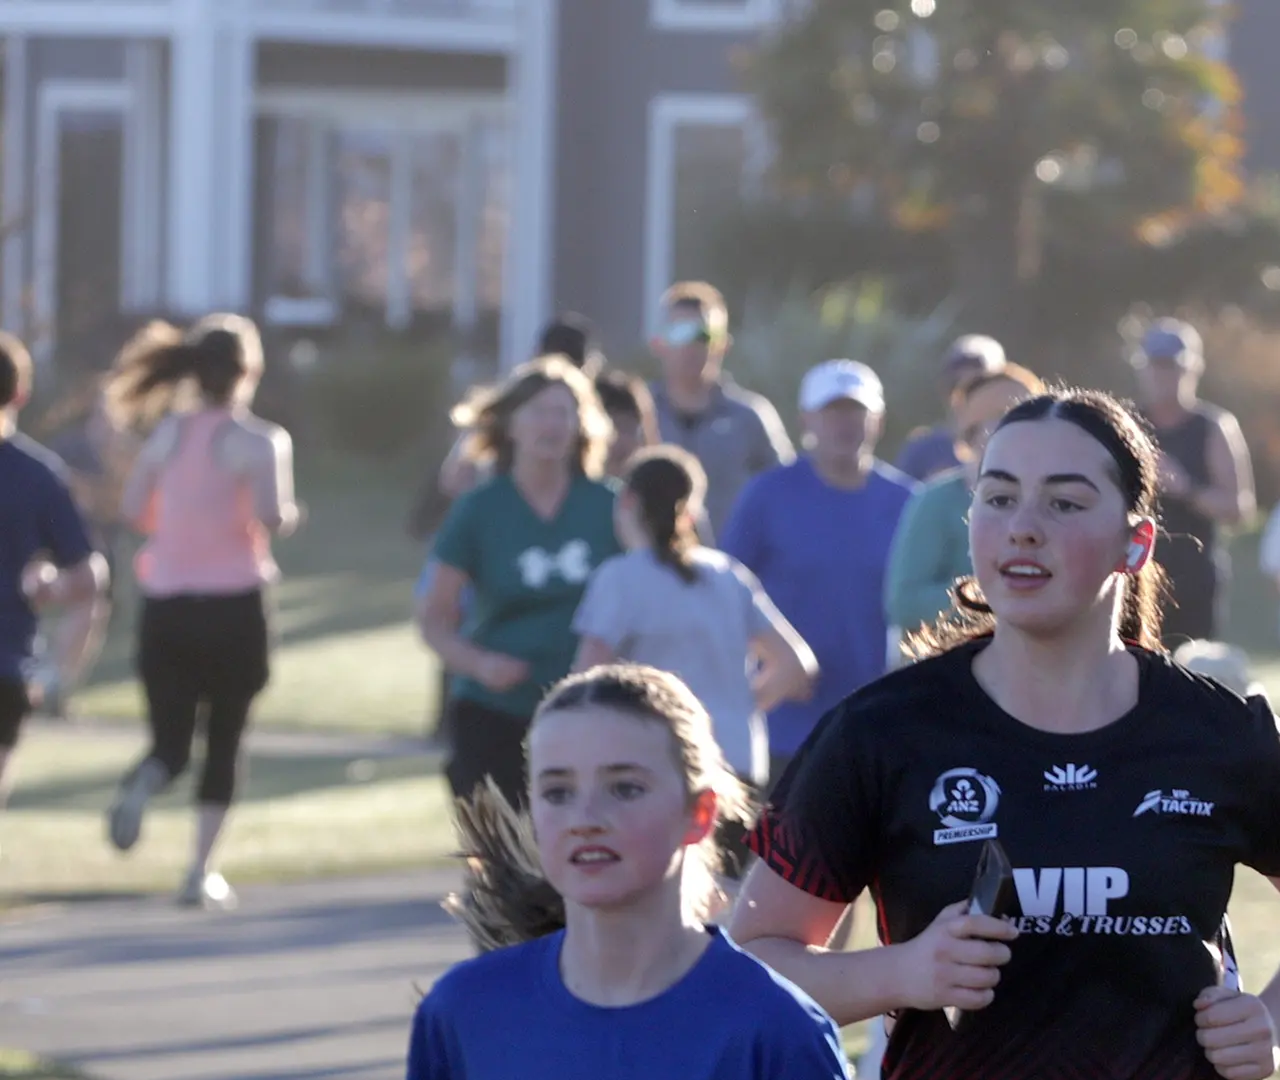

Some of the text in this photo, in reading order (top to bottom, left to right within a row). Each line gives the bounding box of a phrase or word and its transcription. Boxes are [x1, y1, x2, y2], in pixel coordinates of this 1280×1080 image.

[947, 800, 979, 812] ANZ
[1160, 799, 1214, 816] TACTIX
[937, 825, 994, 842] PREMIERSHIP
[1012, 867, 1129, 918] VIP
[1055, 911, 1074, 936] &
[1079, 914, 1192, 935] TRUSSES
